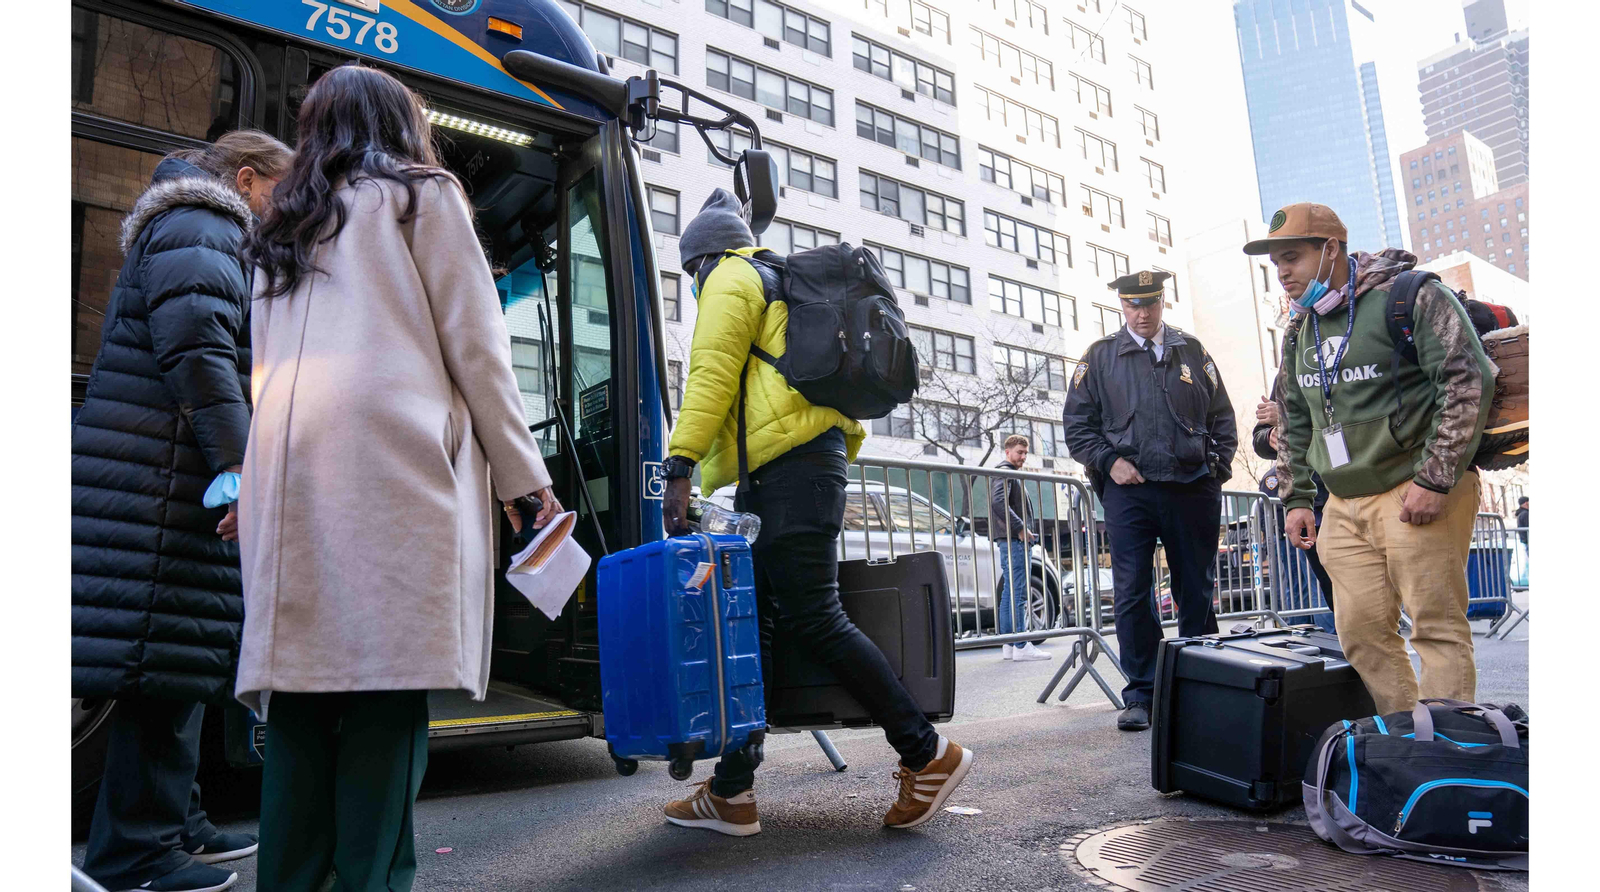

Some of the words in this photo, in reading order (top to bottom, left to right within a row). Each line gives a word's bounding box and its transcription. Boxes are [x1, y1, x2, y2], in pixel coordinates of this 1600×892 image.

[302, 0, 399, 54] 7578
[465, 150, 484, 179] 7578
[1341, 363, 1379, 383] OAK
[1252, 543, 1261, 586] NYPD
